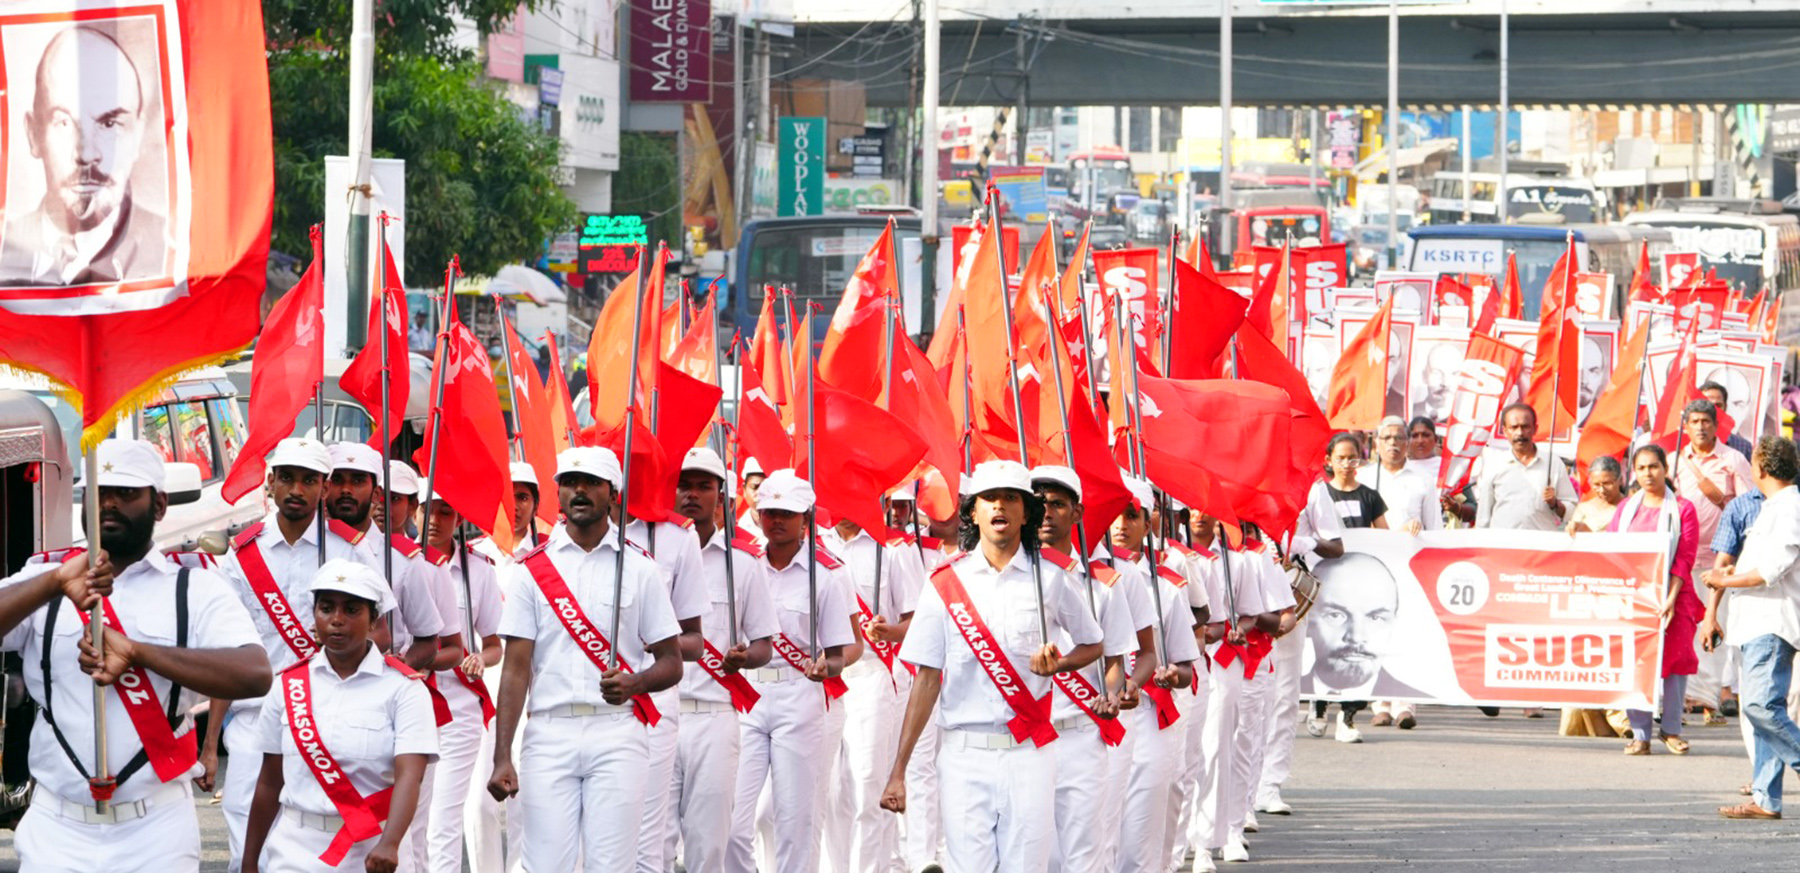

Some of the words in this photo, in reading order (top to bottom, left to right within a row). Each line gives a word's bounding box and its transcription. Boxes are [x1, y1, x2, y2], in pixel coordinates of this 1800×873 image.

[675, 35, 688, 46] &
[675, 49, 688, 91] GOLD
[1511, 189, 1542, 203] A1
[1423, 249, 1495, 264] KSRTC
[1625, 577, 1637, 587] of
[1449, 584, 1476, 606] 20
[949, 602, 1020, 696] KOMSOMOL
[1497, 633, 1623, 668] SUCI
[1496, 669, 1623, 683] COMMUNIST
[288, 677, 341, 785] KOMSOMOL
